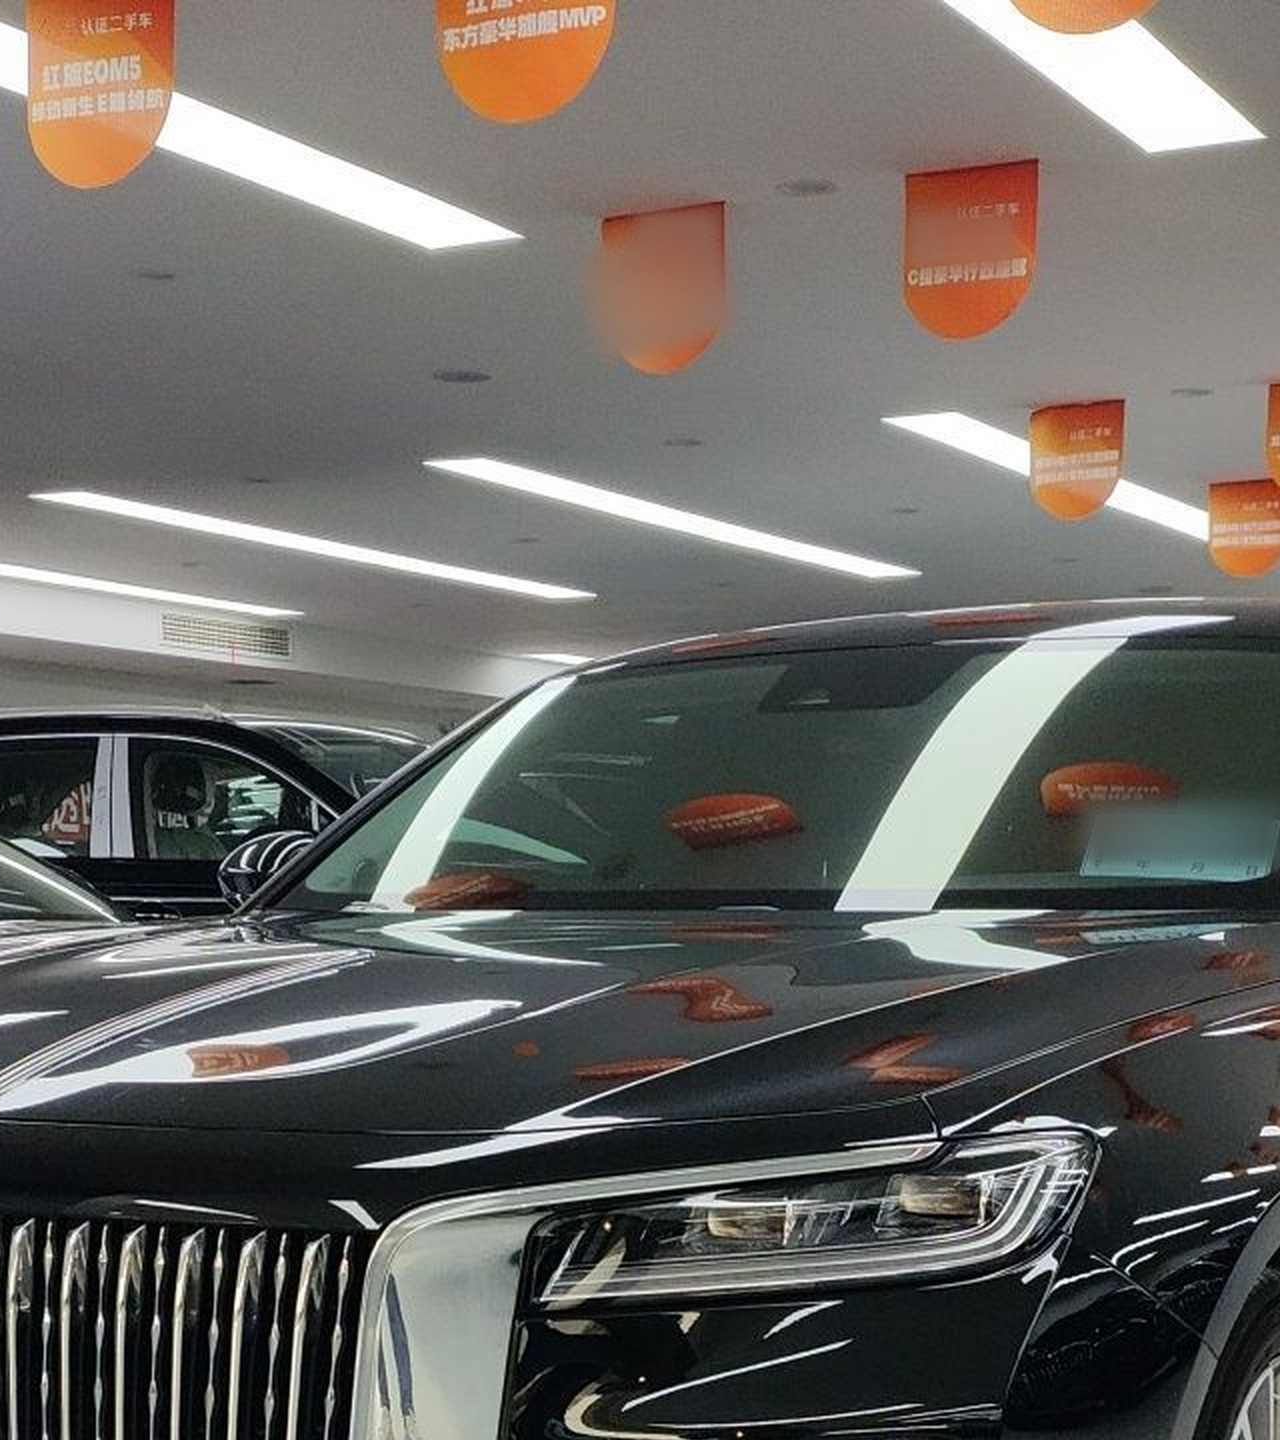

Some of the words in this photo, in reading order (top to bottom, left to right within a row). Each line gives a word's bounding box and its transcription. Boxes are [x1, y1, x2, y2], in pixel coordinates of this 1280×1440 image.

[81, 13, 154, 35] 认证二手车
